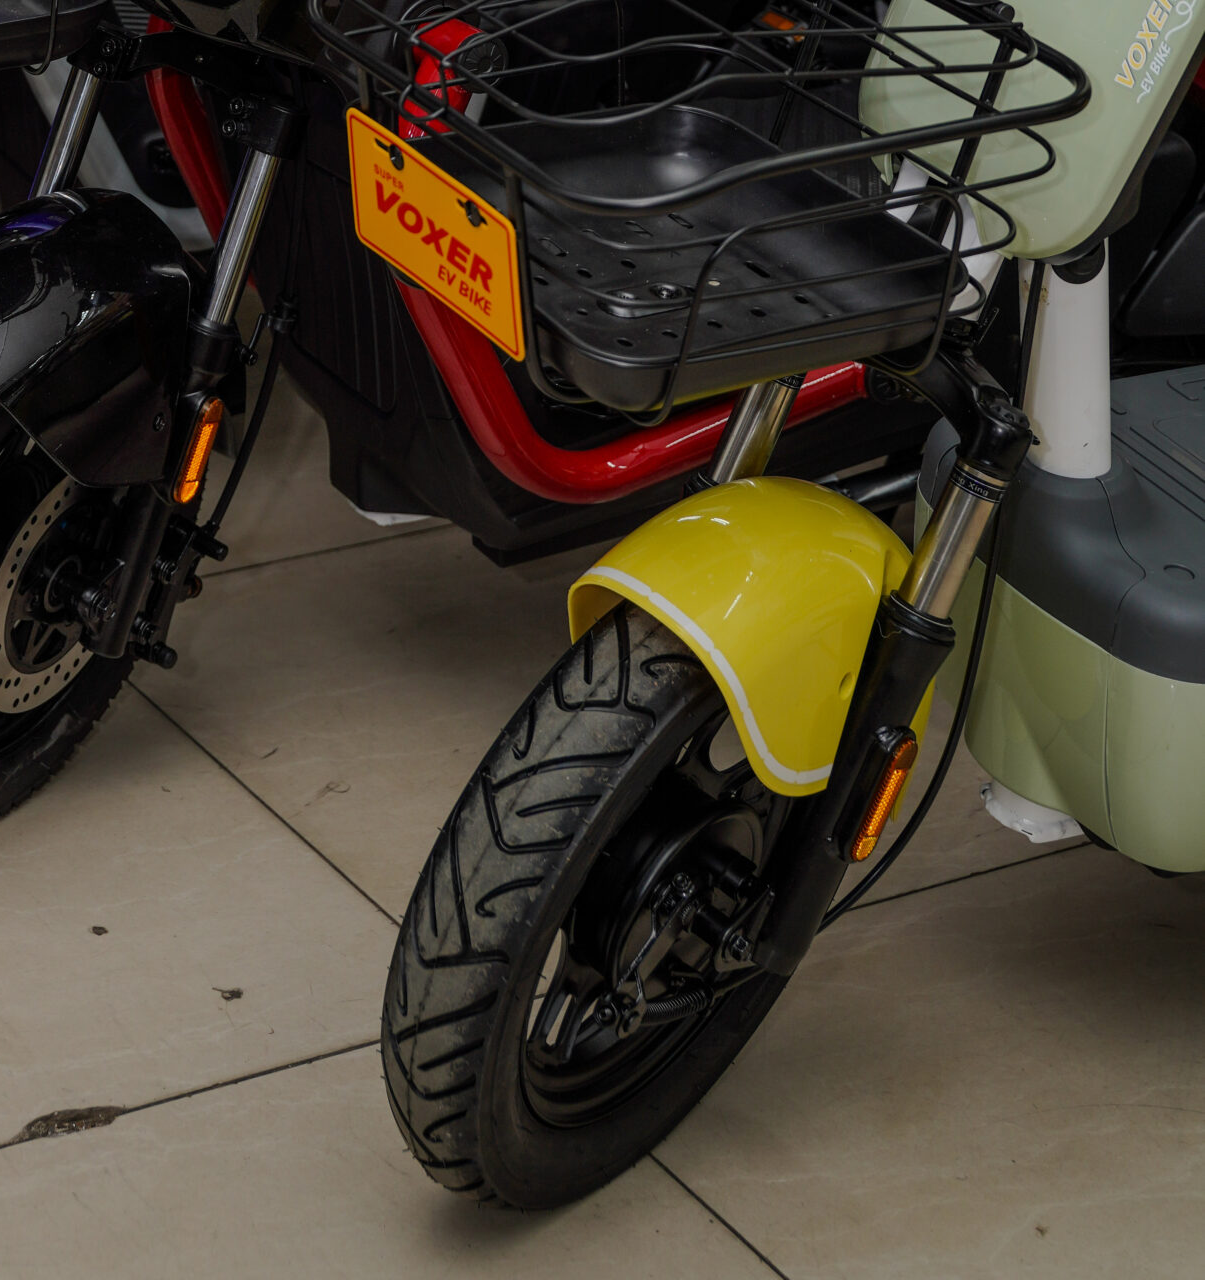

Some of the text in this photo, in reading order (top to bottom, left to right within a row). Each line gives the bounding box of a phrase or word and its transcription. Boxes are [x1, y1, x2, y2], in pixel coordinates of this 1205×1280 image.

[1140, 41, 1172, 94] EV BIKE
[373, 164, 404, 192] SUPER
[375, 179, 493, 294] VOXER
[438, 265, 493, 317] EV BIKE
